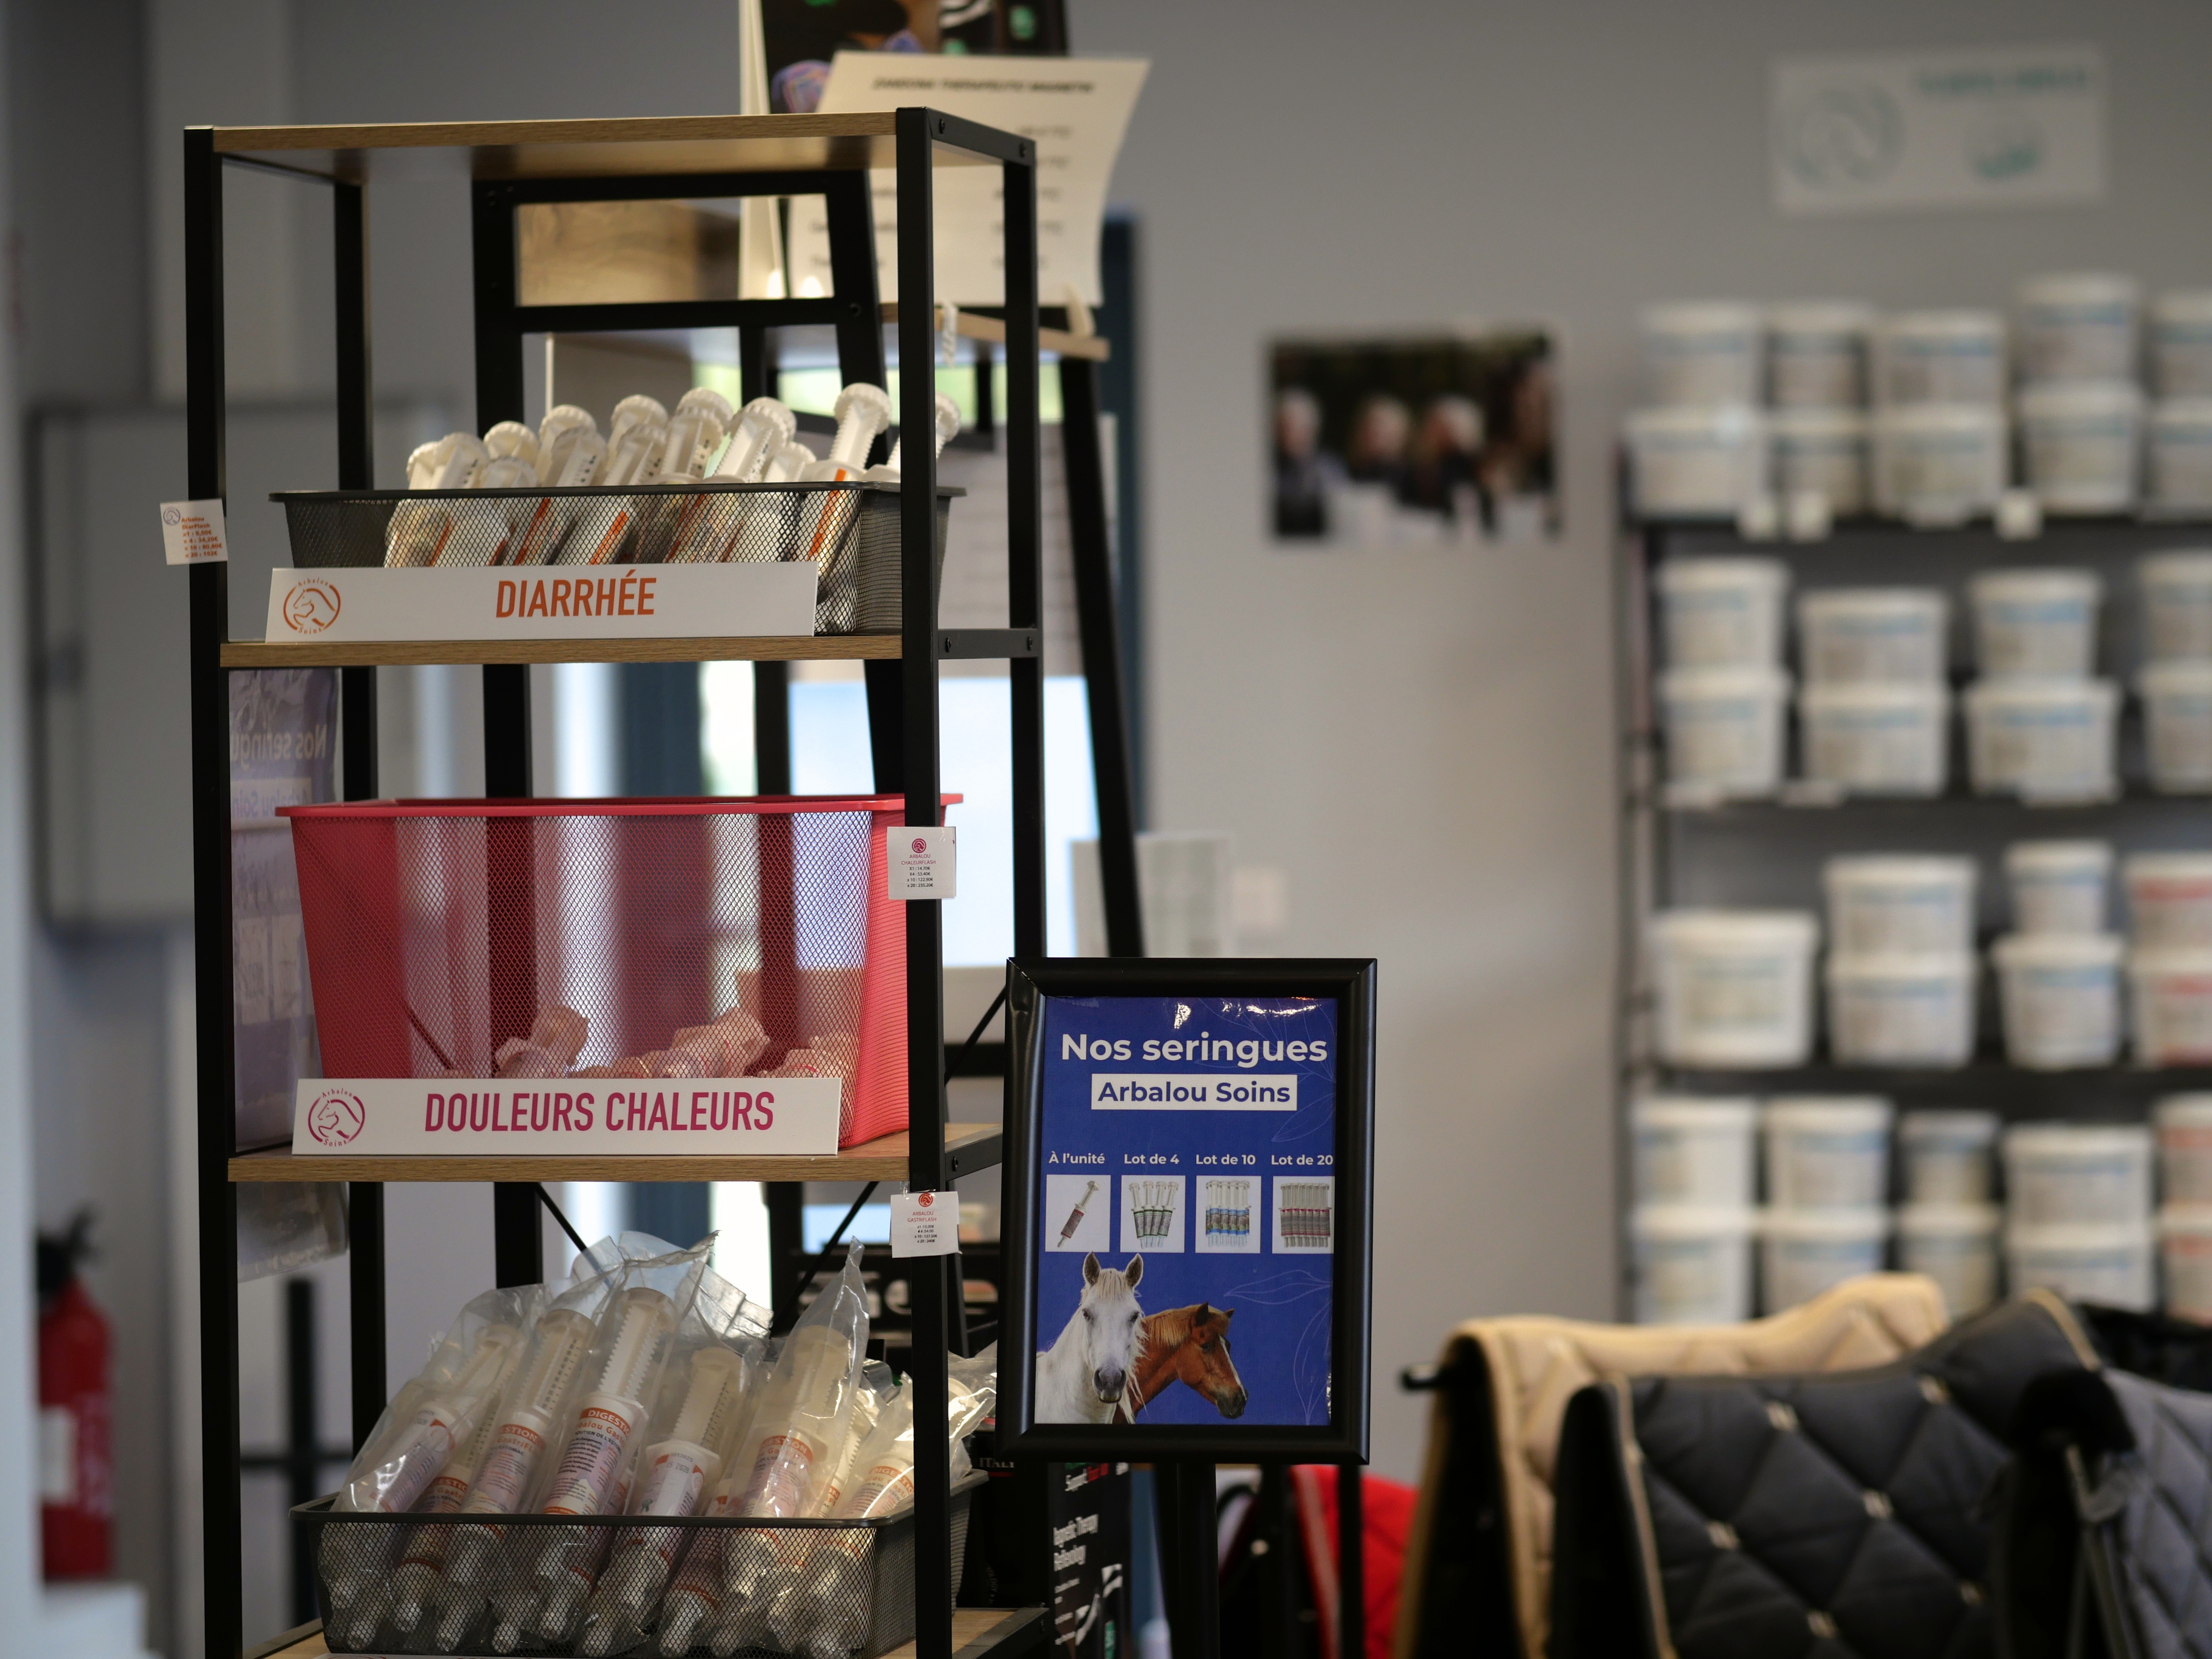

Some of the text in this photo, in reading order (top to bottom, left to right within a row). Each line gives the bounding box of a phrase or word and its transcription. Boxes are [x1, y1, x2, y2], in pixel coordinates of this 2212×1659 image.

[496, 569, 657, 618] DIARRHÉE
[1062, 1031, 1327, 1068] Nos seringues
[1098, 1080, 1290, 1102] Arbalou Soins
[425, 1091, 774, 1132] DOULEURS CHALEURS
[323, 1138, 346, 1147] Soins
[1049, 1151, 1059, 1164] À
[1124, 1154, 1179, 1164] Lot de 4
[1196, 1154, 1256, 1165] Lot de 10
[1271, 1155, 1334, 1165] Lot de 20
[588, 1410, 631, 1436] DIGESTIO
